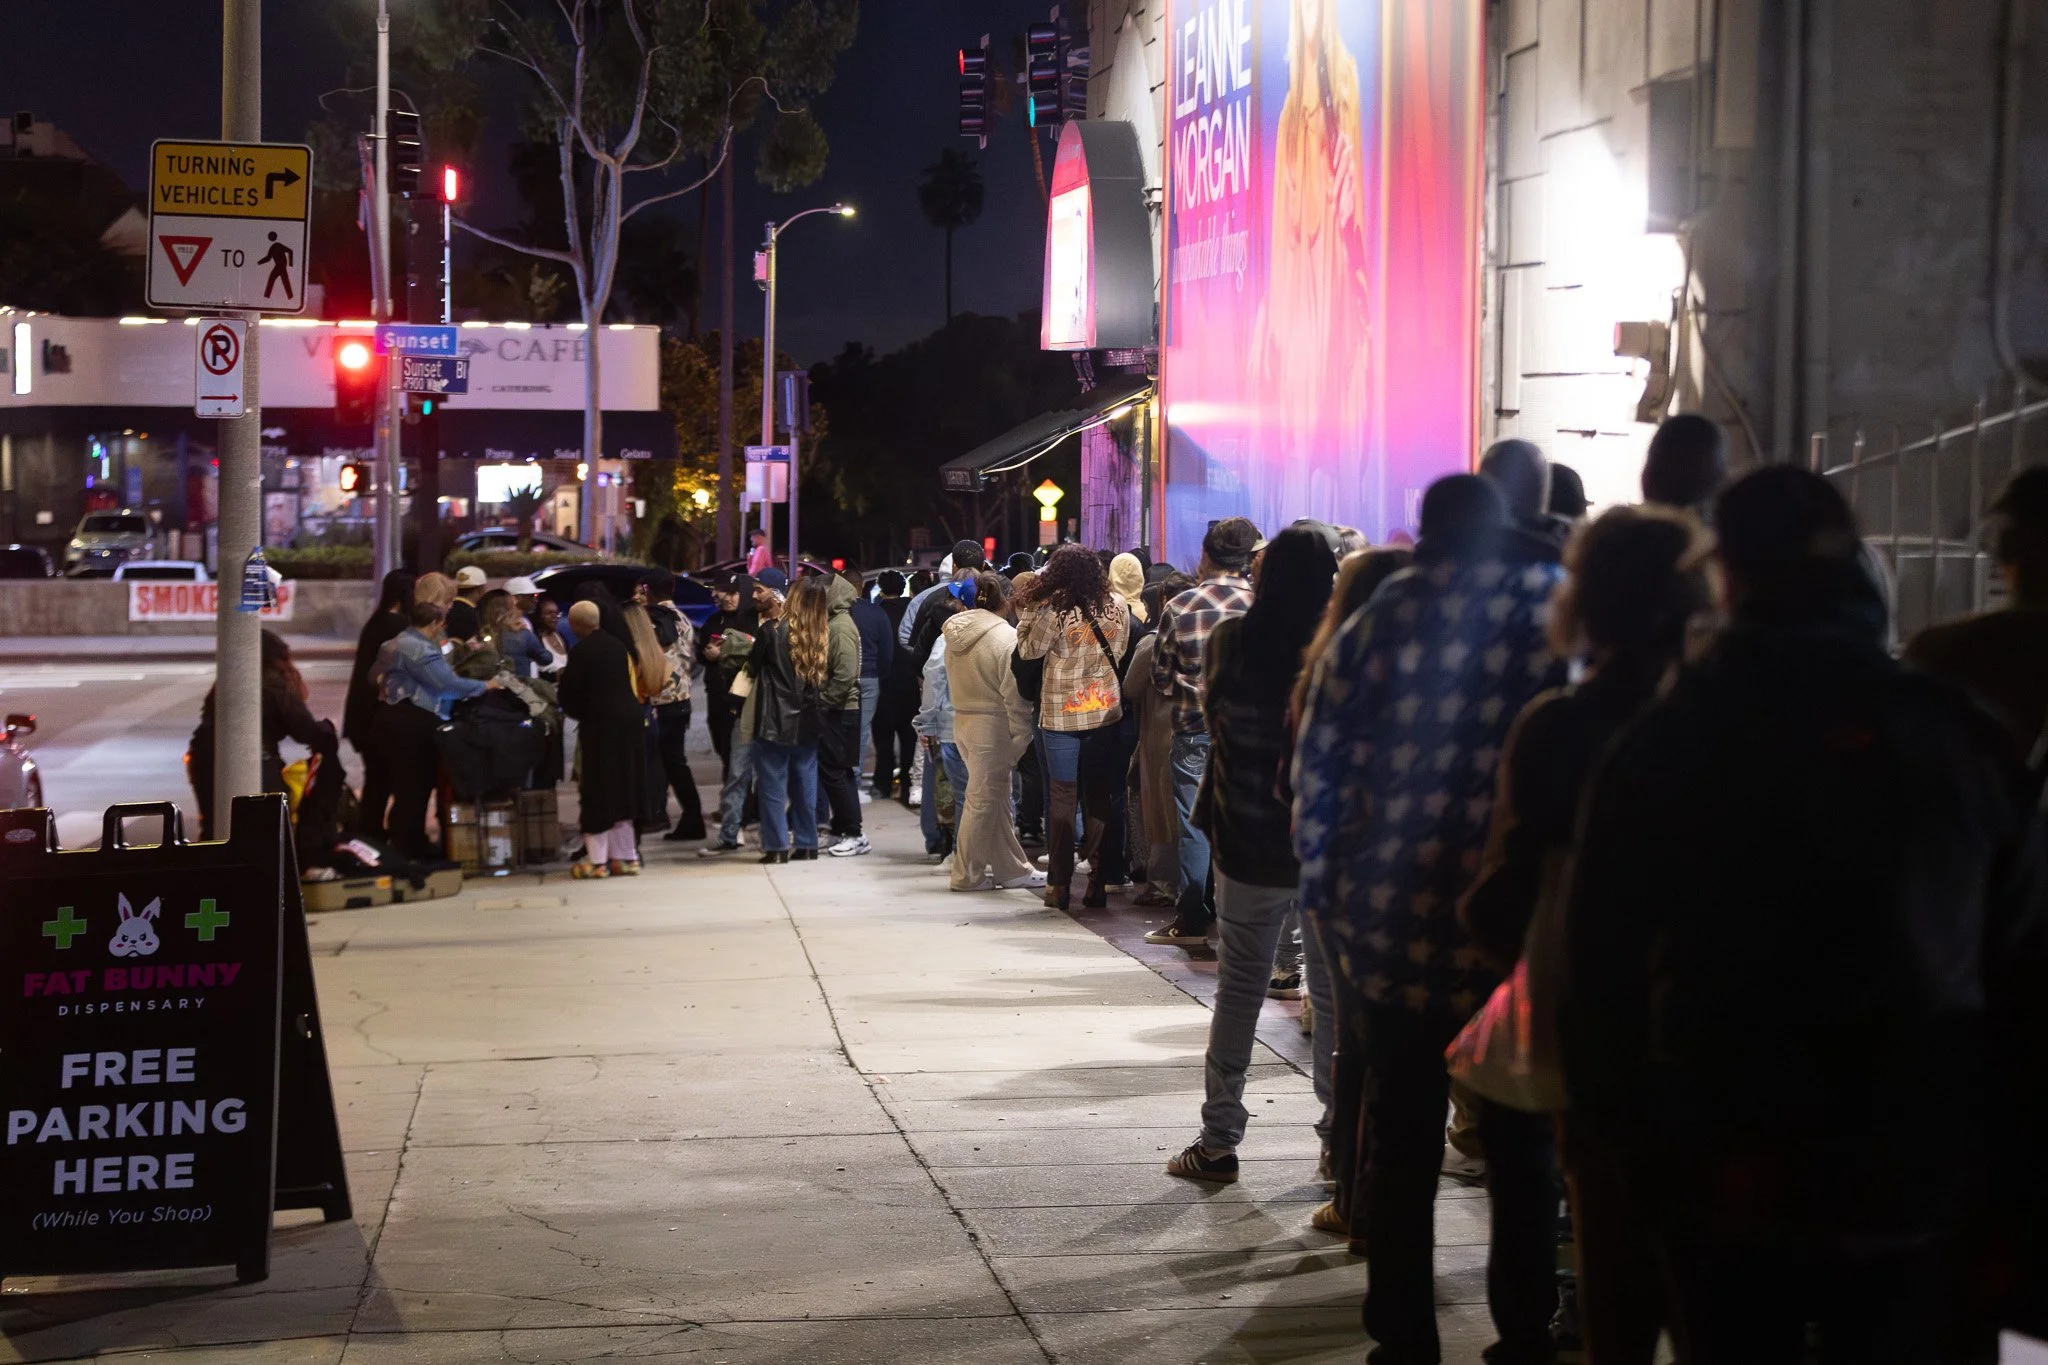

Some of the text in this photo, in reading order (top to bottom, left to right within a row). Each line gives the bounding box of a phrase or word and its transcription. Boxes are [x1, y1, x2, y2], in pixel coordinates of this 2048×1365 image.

[1174, 0, 1252, 120] LEANNE
[165, 154, 255, 177] TURNING
[1173, 94, 1251, 214] MORGAN
[160, 185, 258, 207] VEHICLES
[177, 245, 194, 254] YIELD
[221, 249, 245, 268] TO
[384, 332, 449, 349] Sunset
[404, 358, 467, 379] Sunset Bl
[23, 963, 243, 998] FAT BUNNY
[58, 998, 206, 1016] DISPENSARY
[61, 1048, 197, 1089] FREE
[6, 1097, 248, 1145] PARKING
[53, 1153, 195, 1196] HERE
[32, 1204, 214, 1231] (While You Shop)
